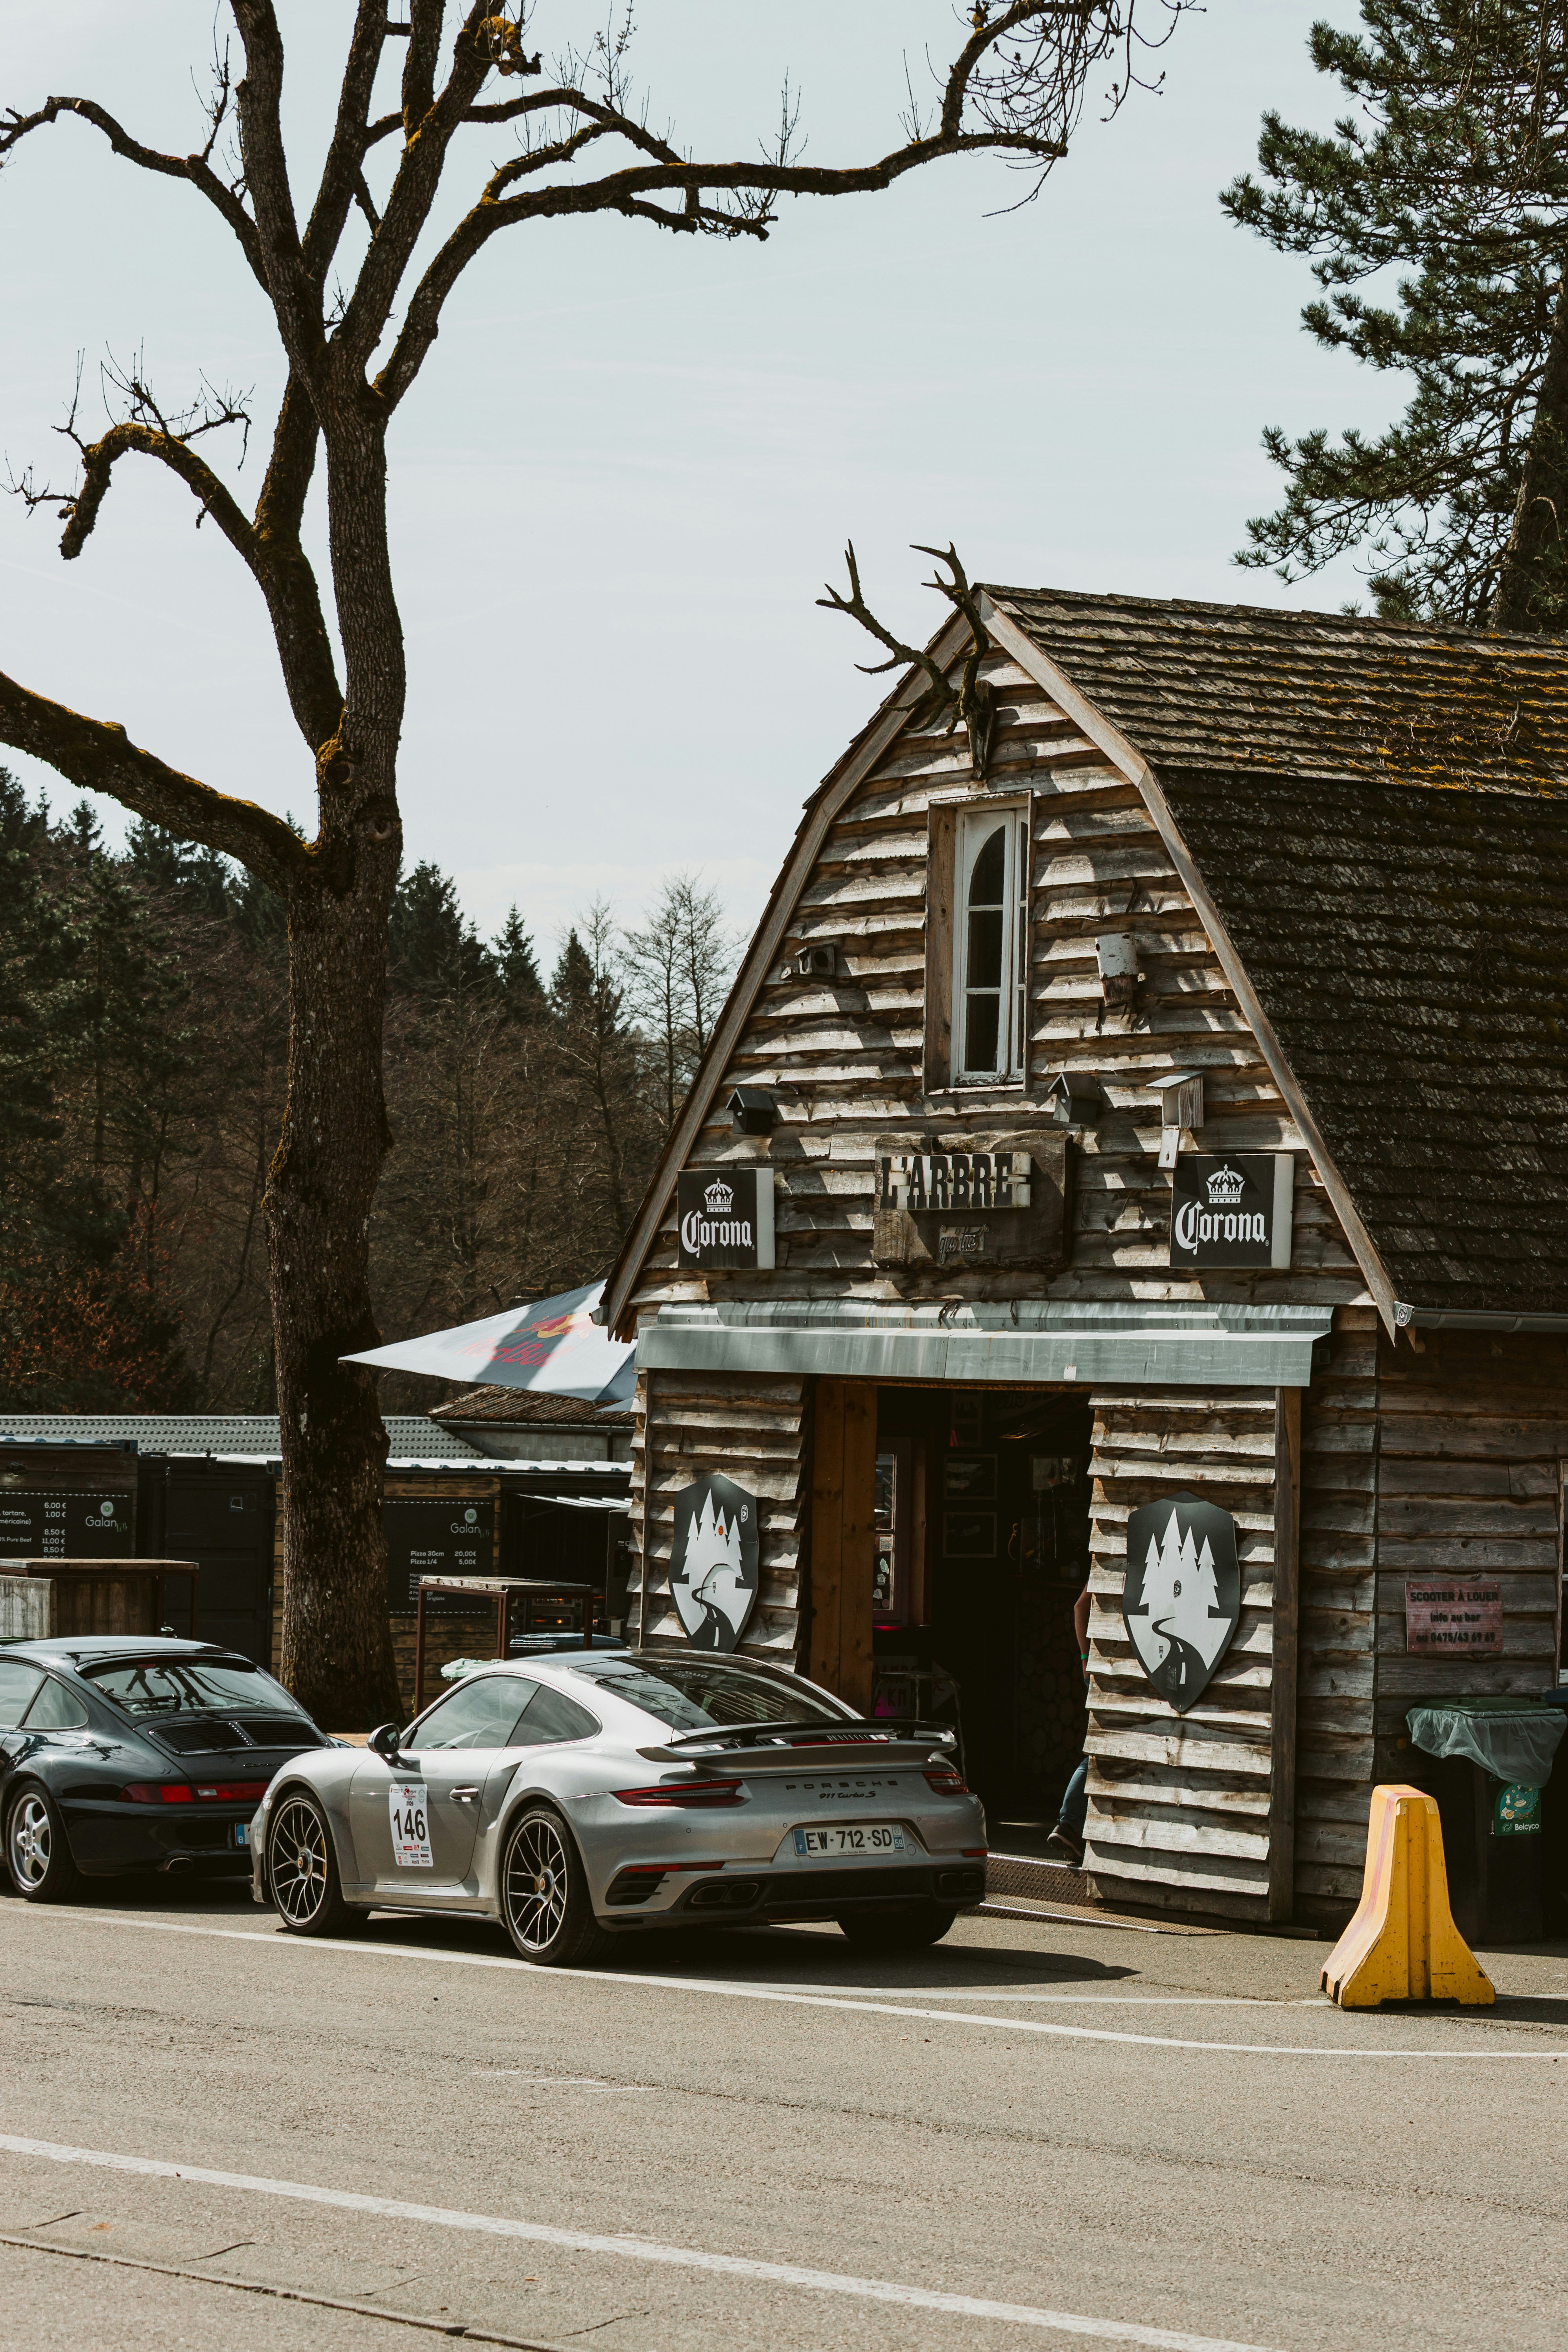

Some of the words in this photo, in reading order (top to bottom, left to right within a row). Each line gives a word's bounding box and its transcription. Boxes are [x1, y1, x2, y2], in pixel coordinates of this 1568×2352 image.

[880, 1152, 1013, 1209] L'ARBRE
[681, 1210, 752, 1258] Corona
[1175, 1201, 1266, 1255] Corona
[85, 1516, 117, 1527] Galan
[451, 1523, 480, 1533] Galan
[1410, 1592, 1455, 1602] SCOOTER
[1457, 1589, 1465, 1601] À
[1467, 1591, 1499, 1601] LOUER
[1465, 1612, 1481, 1622] bar
[1430, 1631, 1469, 1643] 0475/43
[786, 1781, 898, 1790] PORSCHE
[394, 1809, 426, 1841] 146
[1515, 1823, 1539, 1831] Belcyco
[805, 1829, 892, 1851] EW-712-SD
[895, 1839, 903, 1847] 59
